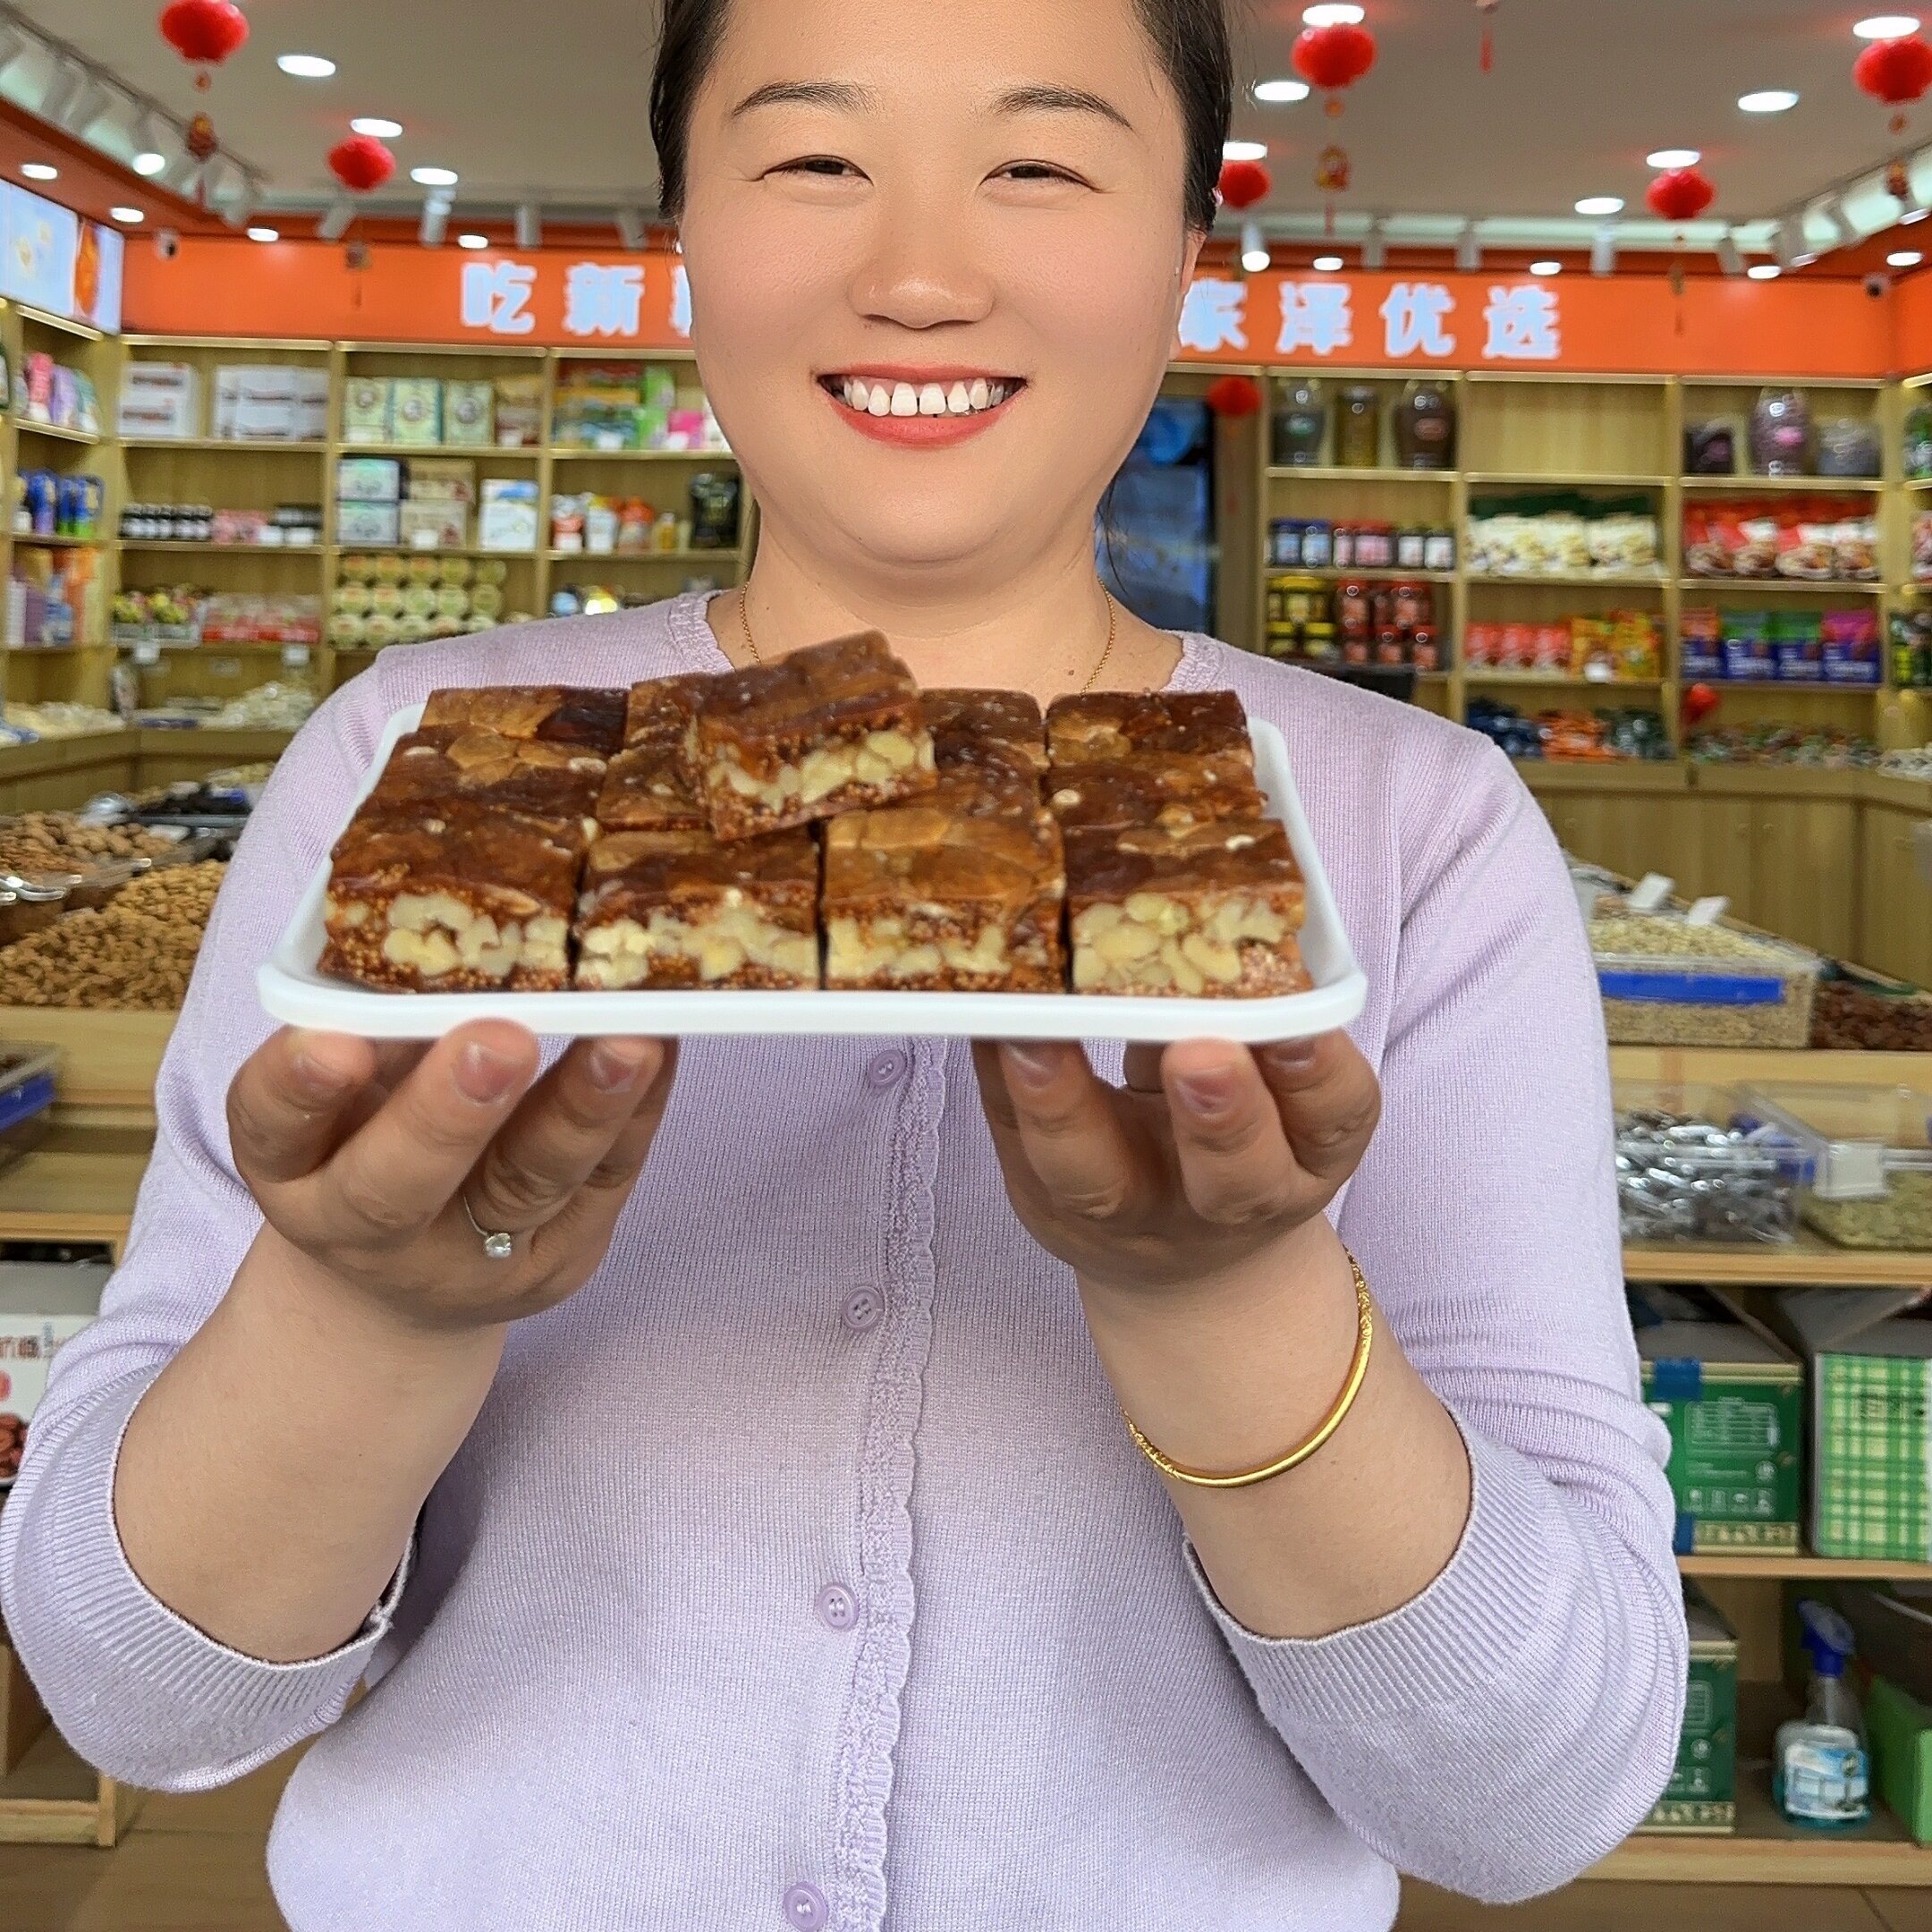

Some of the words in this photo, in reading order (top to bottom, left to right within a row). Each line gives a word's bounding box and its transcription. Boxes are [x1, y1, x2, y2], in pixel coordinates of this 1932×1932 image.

[461, 261, 692, 336] 吃新
[1178, 277, 1561, 359] 家泽优选
